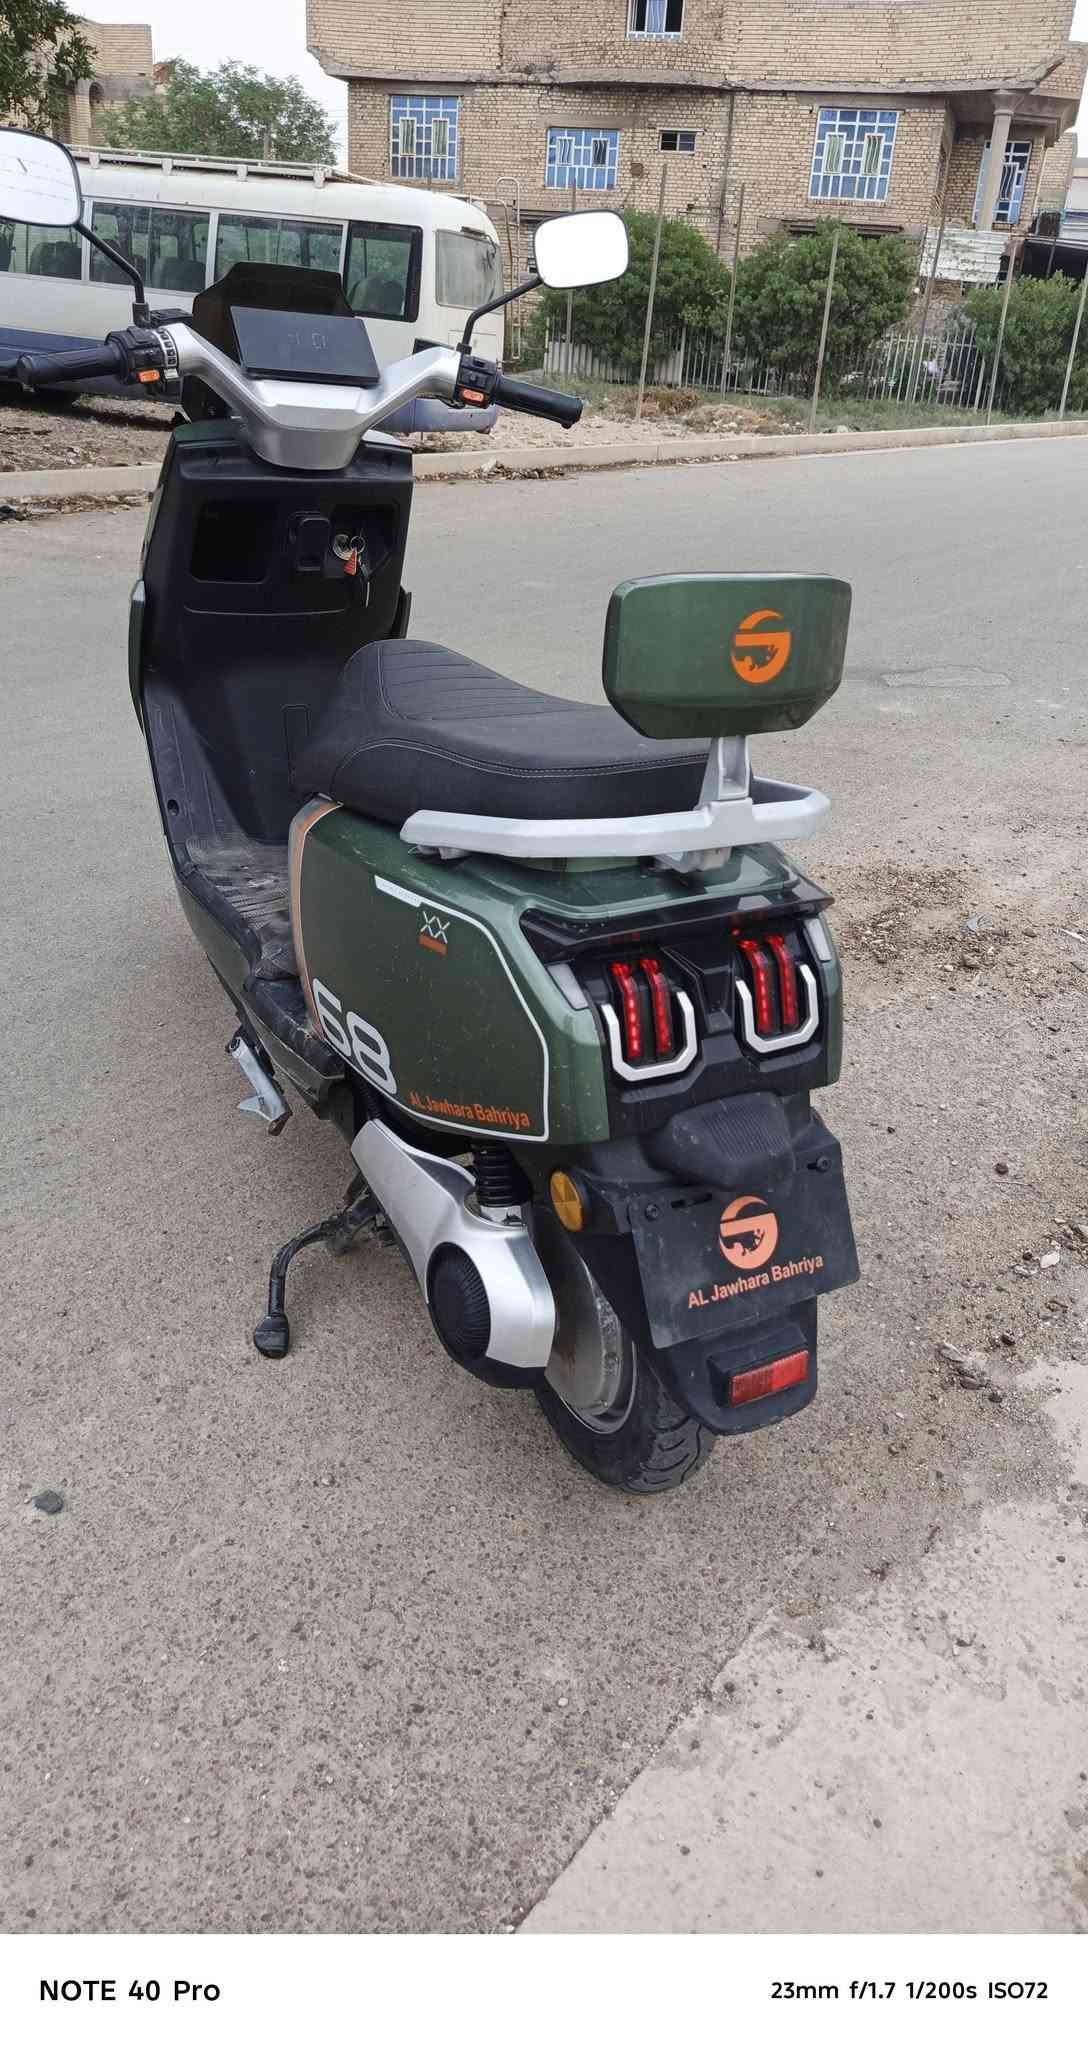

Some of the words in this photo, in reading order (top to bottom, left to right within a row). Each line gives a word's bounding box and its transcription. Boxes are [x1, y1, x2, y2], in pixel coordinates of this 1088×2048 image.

[313, 978, 397, 1094] 68
[474, 1104, 530, 1130] Bahriya
[688, 1289, 709, 1309] AL
[711, 1273, 770, 1301] Jawhara
[771, 1255, 823, 1281] Bahriya
